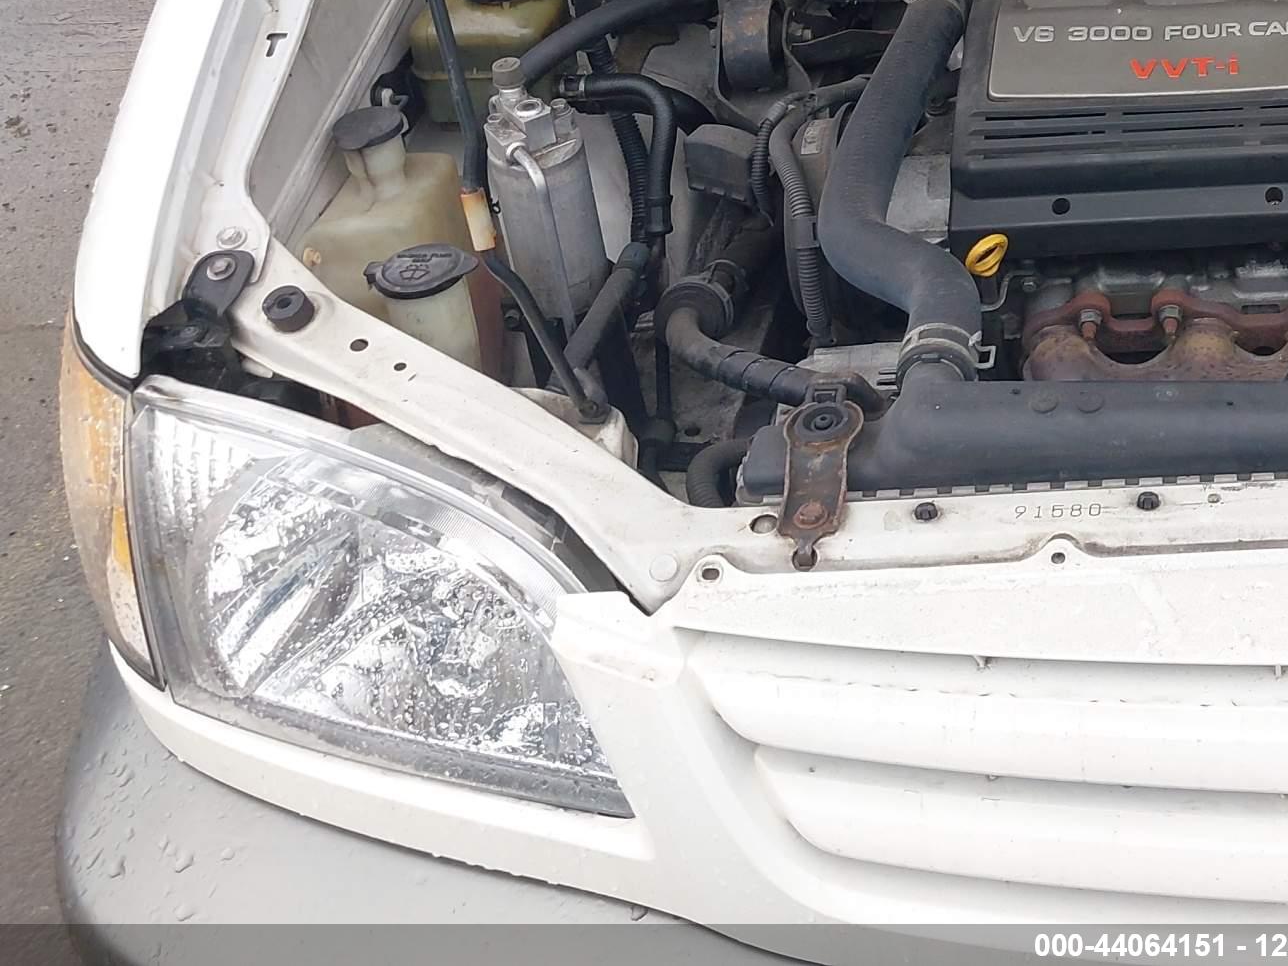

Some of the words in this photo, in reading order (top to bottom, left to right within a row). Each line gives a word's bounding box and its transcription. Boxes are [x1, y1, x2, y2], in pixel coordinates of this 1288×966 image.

[1013, 25, 1055, 42] V6
[1067, 25, 1152, 42] 3000
[1164, 21, 1242, 41] FOUR
[1129, 53, 1240, 79] VVT-i
[1014, 503, 1102, 519] 91580
